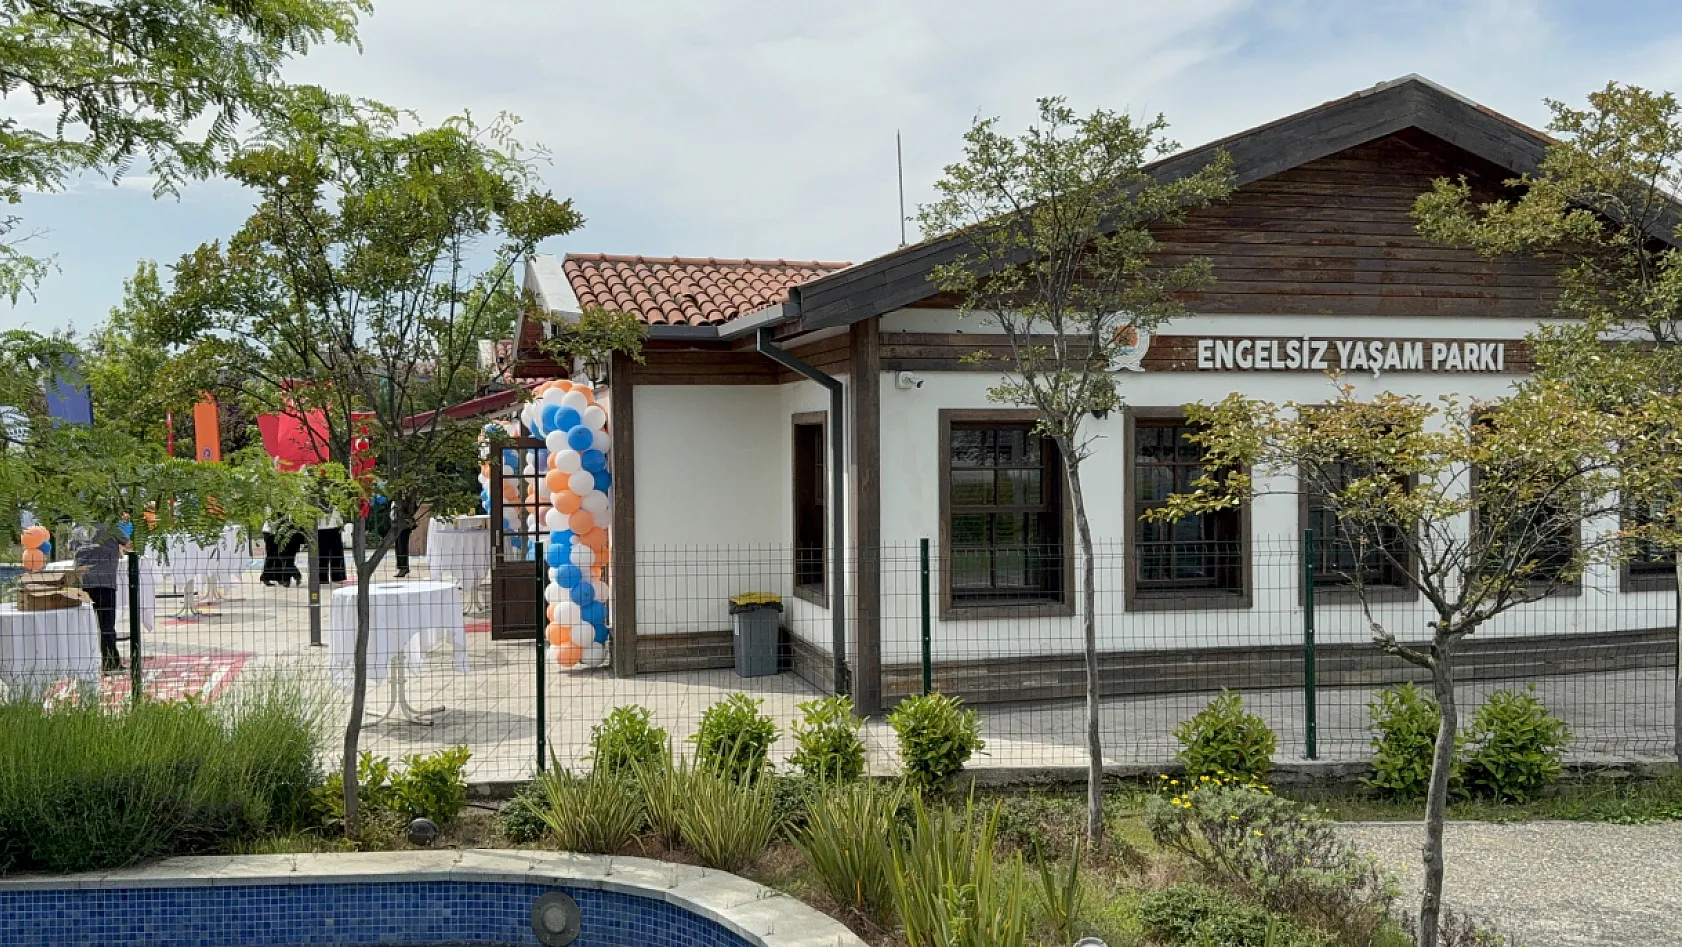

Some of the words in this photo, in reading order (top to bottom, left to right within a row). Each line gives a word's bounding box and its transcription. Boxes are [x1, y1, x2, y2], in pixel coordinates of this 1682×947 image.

[1198, 335, 1328, 369] ENGELSİZ
[1335, 340, 1424, 379] YAŞAM
[1431, 341, 1504, 371] PARKI
